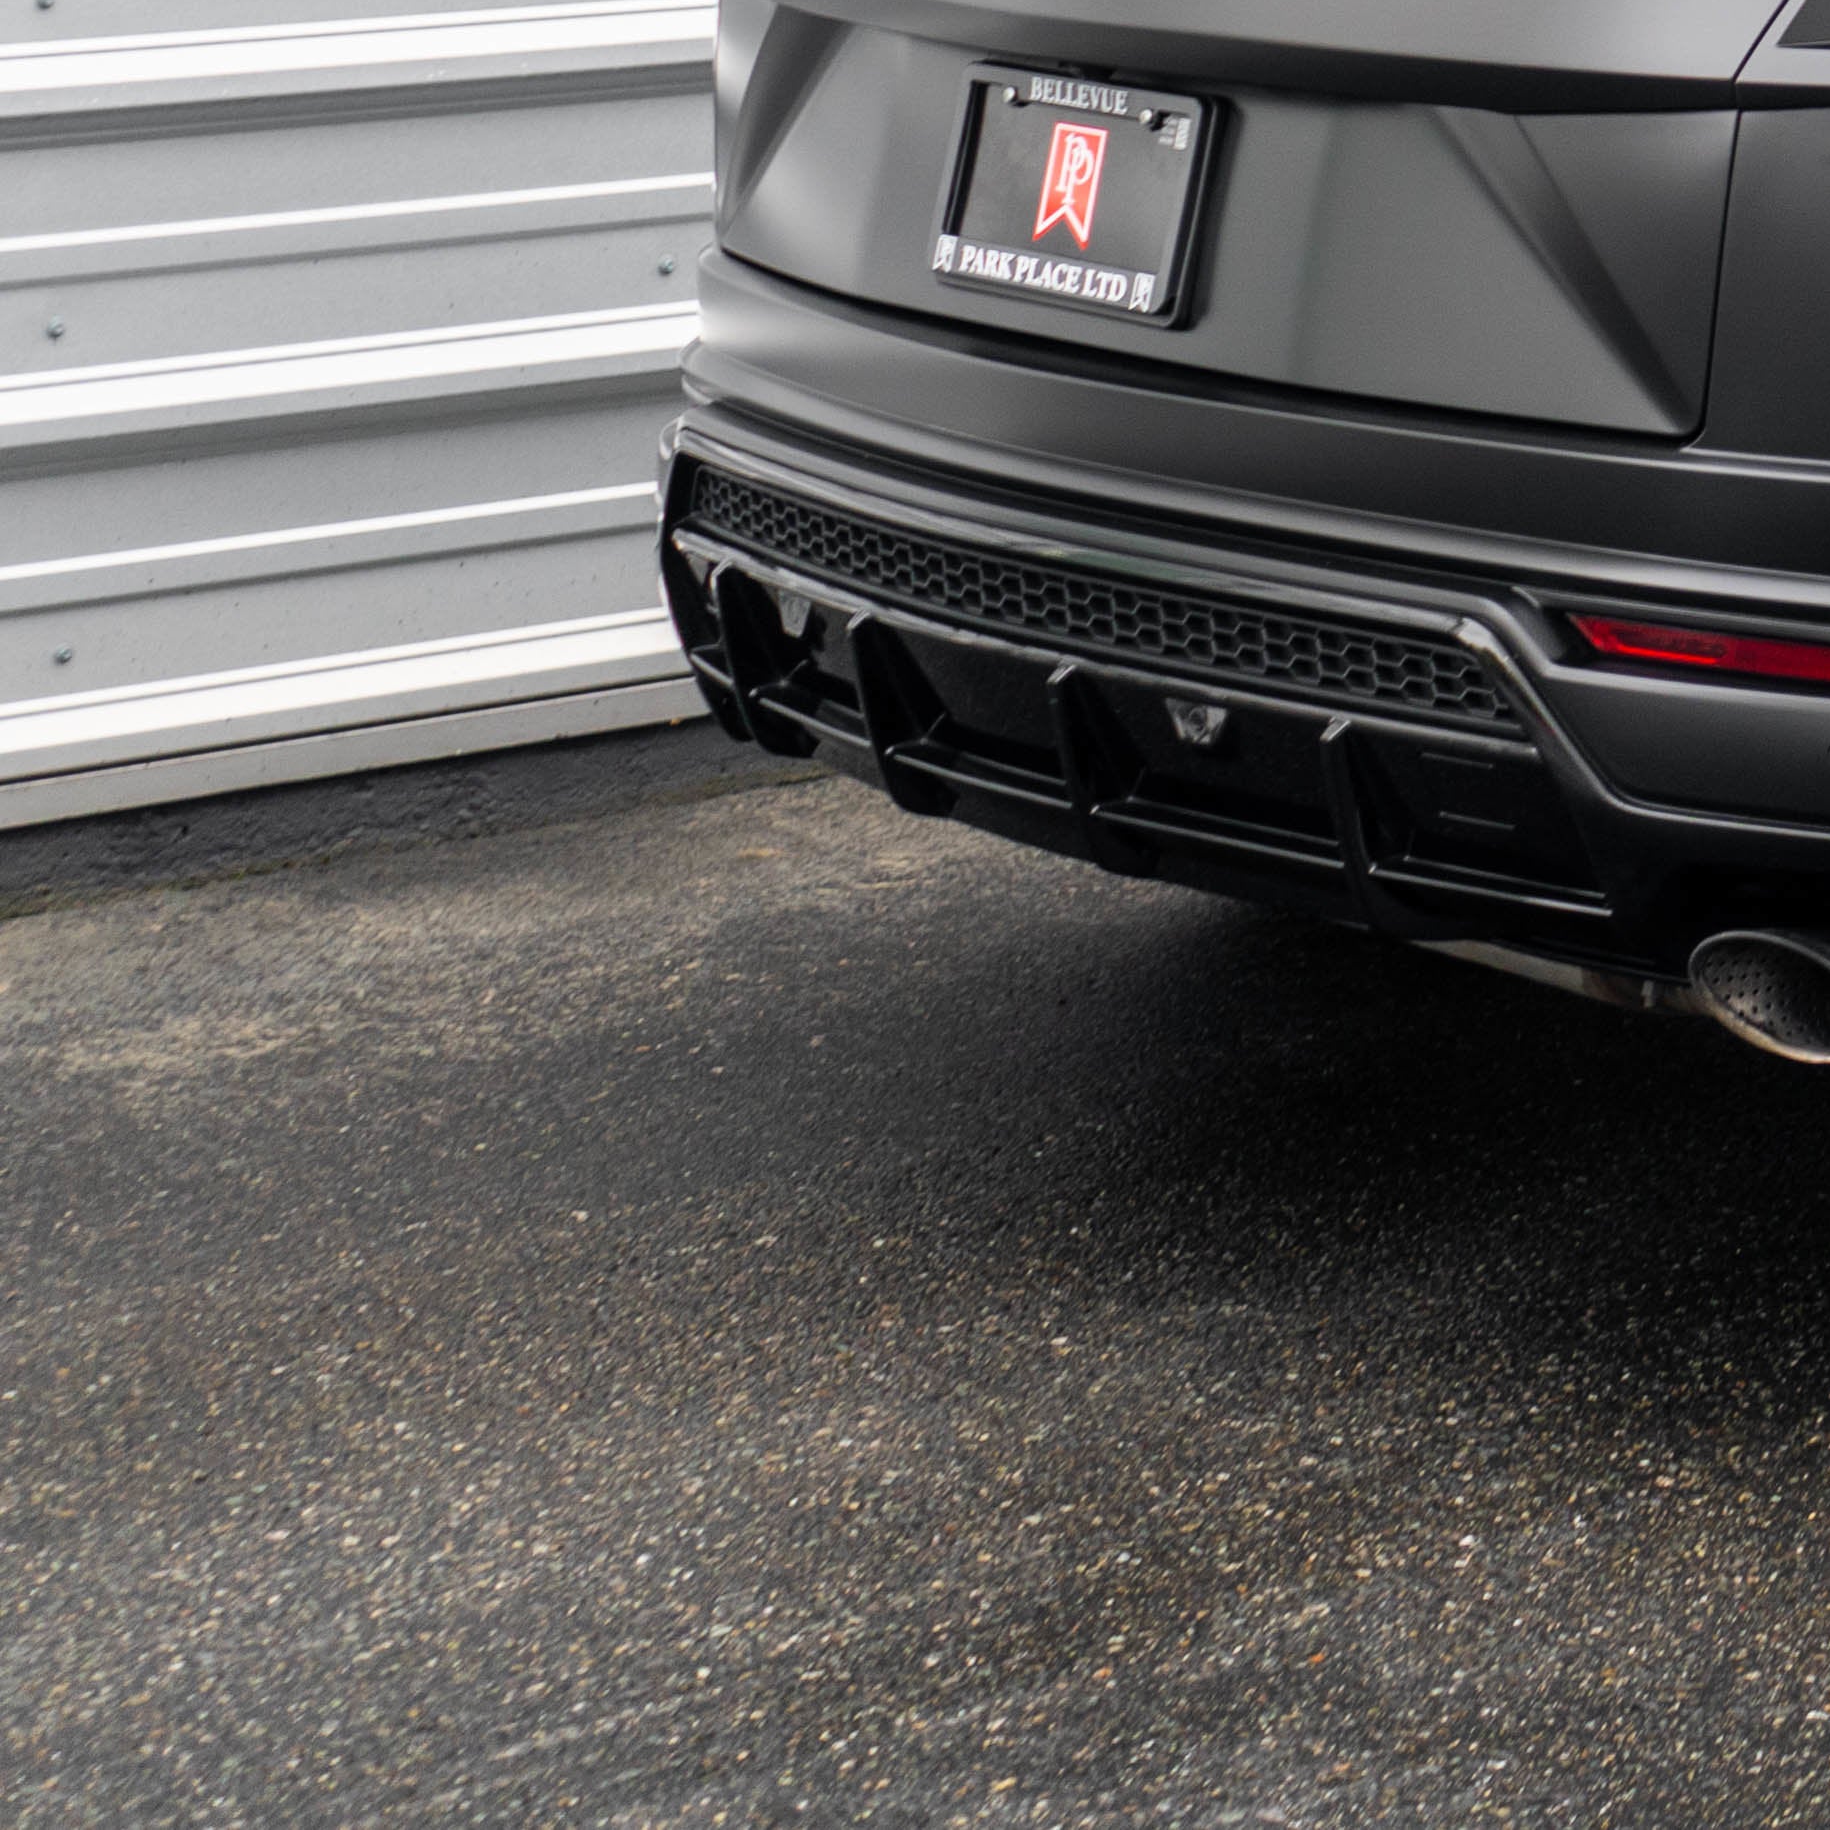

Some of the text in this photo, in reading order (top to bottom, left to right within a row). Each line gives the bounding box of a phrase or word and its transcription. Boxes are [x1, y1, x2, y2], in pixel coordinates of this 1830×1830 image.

[1030, 76, 1128, 115] BELLEVUE
[959, 244, 1017, 281] PARK
[1012, 255, 1082, 294] PLACE
[1080, 268, 1128, 303] LTD
